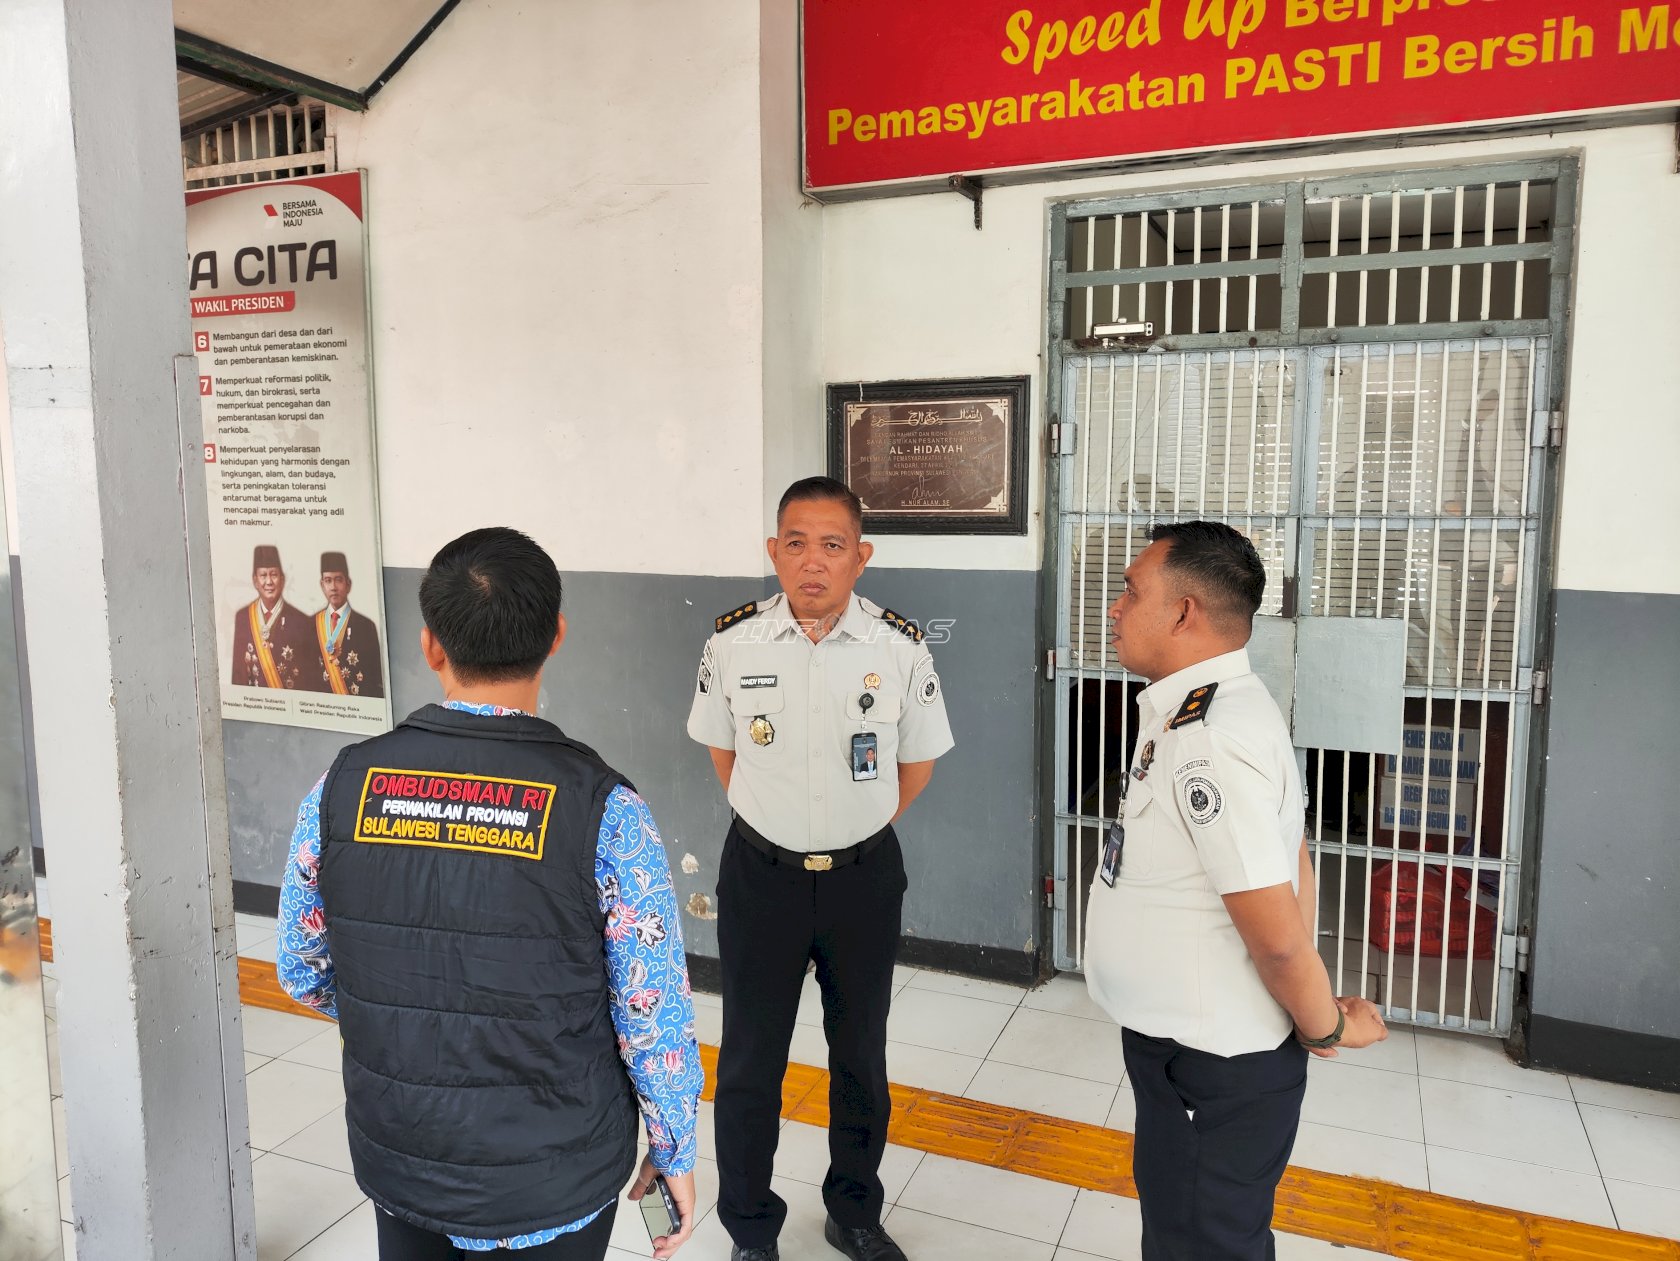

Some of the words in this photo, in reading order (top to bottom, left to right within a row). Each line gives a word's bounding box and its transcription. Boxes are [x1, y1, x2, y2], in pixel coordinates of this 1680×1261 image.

[1001, 0, 1161, 74] Speed
[1183, 0, 1264, 50] Up
[828, 71, 1205, 145] Pemasyarakatan
[1225, 40, 1381, 100] PASTI
[1403, 15, 1594, 80] Bersih
[1618, 4, 1680, 54] M
[282, 200, 317, 210] BERSAMA
[283, 208, 324, 218] INDONESIA
[284, 218, 302, 227] MAJU
[188, 250, 218, 291] A
[234, 240, 338, 286] CITA
[194, 299, 229, 313] WAKIL
[232, 296, 284, 311] PRESIDEN
[198, 336, 207, 348] 6
[213, 331, 260, 341] Membangun
[261, 329, 276, 338] dari
[278, 328, 298, 338] desa
[300, 327, 314, 336] dan
[316, 326, 333, 336] dari
[213, 344, 238, 353] bawah
[240, 342, 262, 352] untuk
[264, 340, 311, 352] pemerataan
[313, 339, 347, 348] ekonomi
[214, 357, 228, 366] dan
[230, 355, 290, 367] pemberantasan
[292, 353, 338, 363] kemiskinan.
[200, 379, 209, 392] 7
[216, 377, 262, 388] Memperkuat
[264, 375, 302, 383] reformasi
[305, 374, 332, 384] politik,
[216, 389, 244, 398] hukum,
[246, 388, 259, 396] dan
[262, 388, 298, 396] birokrasi,
[216, 401, 264, 411] memperkuat
[266, 400, 313, 410] pencegahan
[316, 400, 330, 408] dan
[218, 413, 276, 422] pemberantasan
[278, 412, 306, 422] korupsi
[309, 412, 324, 420] dan
[218, 426, 250, 434] narkoba.
[204, 447, 214, 460] 8
[220, 445, 266, 455] Memperkuat
[268, 445, 320, 454] penyelarasan
[890, 446, 904, 454] AL
[914, 444, 963, 454] HIDAYAH
[220, 458, 258, 468] kehidupan
[260, 459, 279, 468] yang
[281, 458, 318, 466] harmonis
[320, 458, 350, 468] dengan
[221, 470, 263, 480] lingkungan,
[266, 470, 286, 479] alam,
[304, 470, 336, 480] budaya,
[244, 482, 290, 492] peningkatan
[292, 482, 326, 490] toleransi
[222, 494, 262, 502] antarumat
[264, 494, 302, 504] beragama
[304, 495, 327, 503] untuk
[224, 506, 259, 516] mencapai
[261, 506, 306, 516] masyarakat
[308, 508, 328, 517] yang
[240, 518, 272, 526] makmur.
[372, 774, 514, 806] OMBUDSMAN
[522, 788, 546, 810] RI
[382, 799, 464, 821] PERWAKILAN
[466, 806, 528, 828] PROVINSI
[363, 816, 440, 841] SULAWESI
[446, 823, 534, 852] TENGGARA
